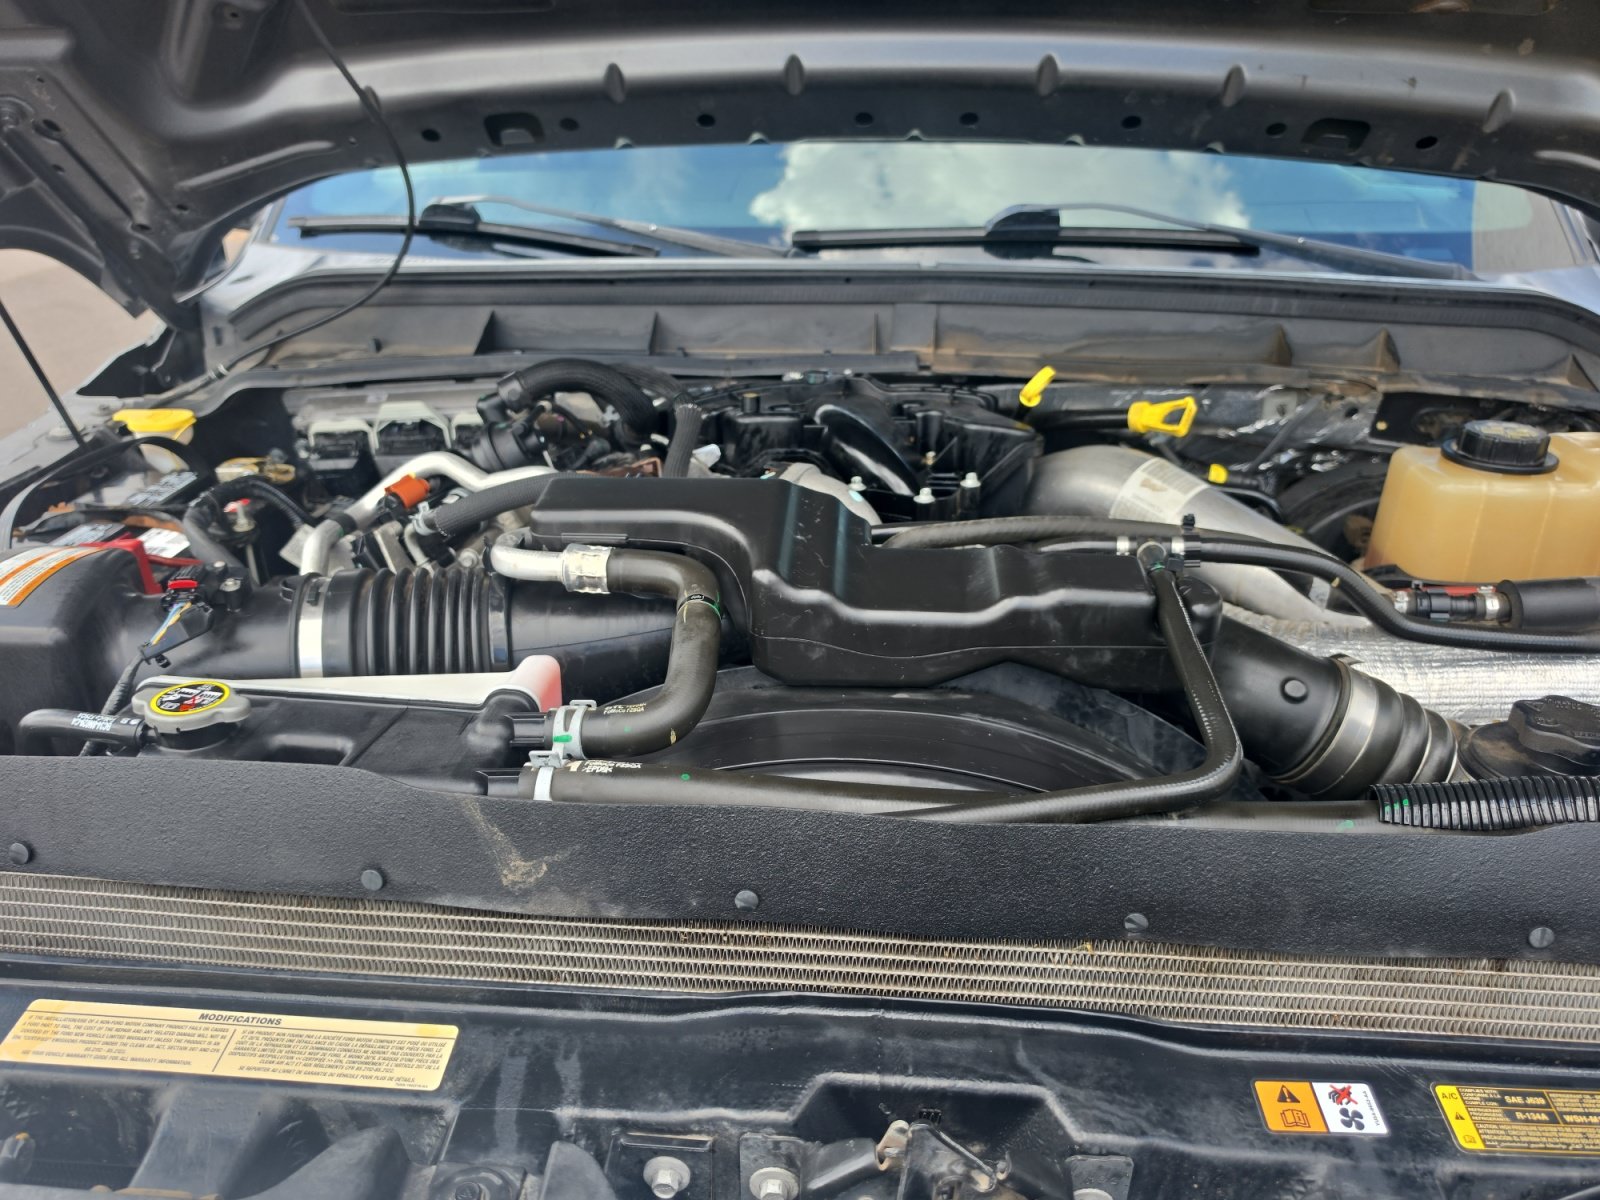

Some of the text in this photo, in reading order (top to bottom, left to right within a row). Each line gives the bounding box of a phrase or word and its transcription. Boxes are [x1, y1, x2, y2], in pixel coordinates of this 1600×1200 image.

[199, 1013, 282, 1025] MODIFICATIONS
[1441, 1092, 1459, 1100] A/C
[1504, 1095, 1524, 1104] SAE
[1515, 1112, 1550, 1121] R-134A
